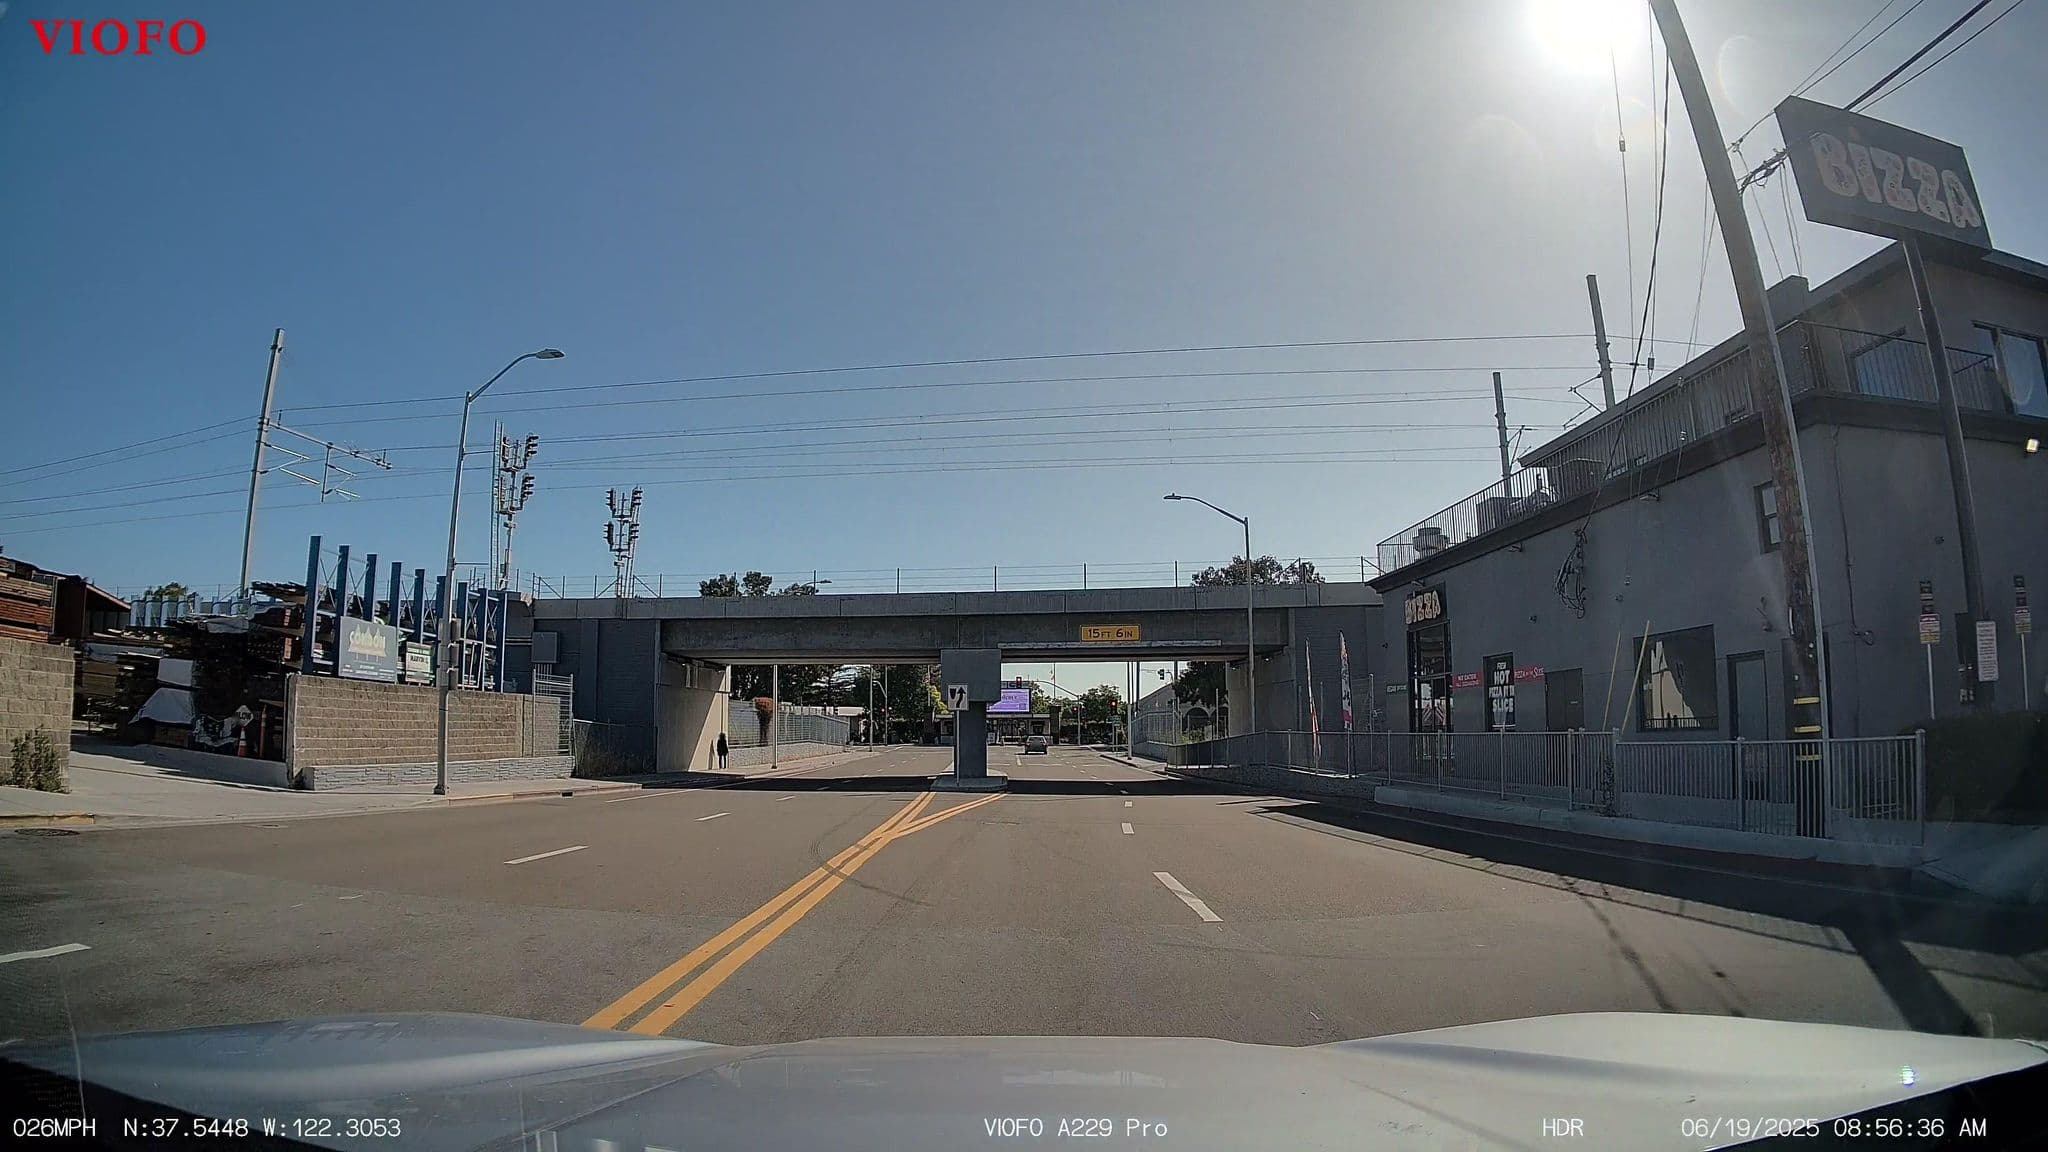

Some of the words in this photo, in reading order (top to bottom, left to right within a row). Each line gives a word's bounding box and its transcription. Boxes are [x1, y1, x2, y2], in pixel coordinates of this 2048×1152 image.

[1808, 130, 1982, 229] BIZZA
[1494, 670, 1510, 685] HOT
[1493, 698, 1514, 713] SLICE
